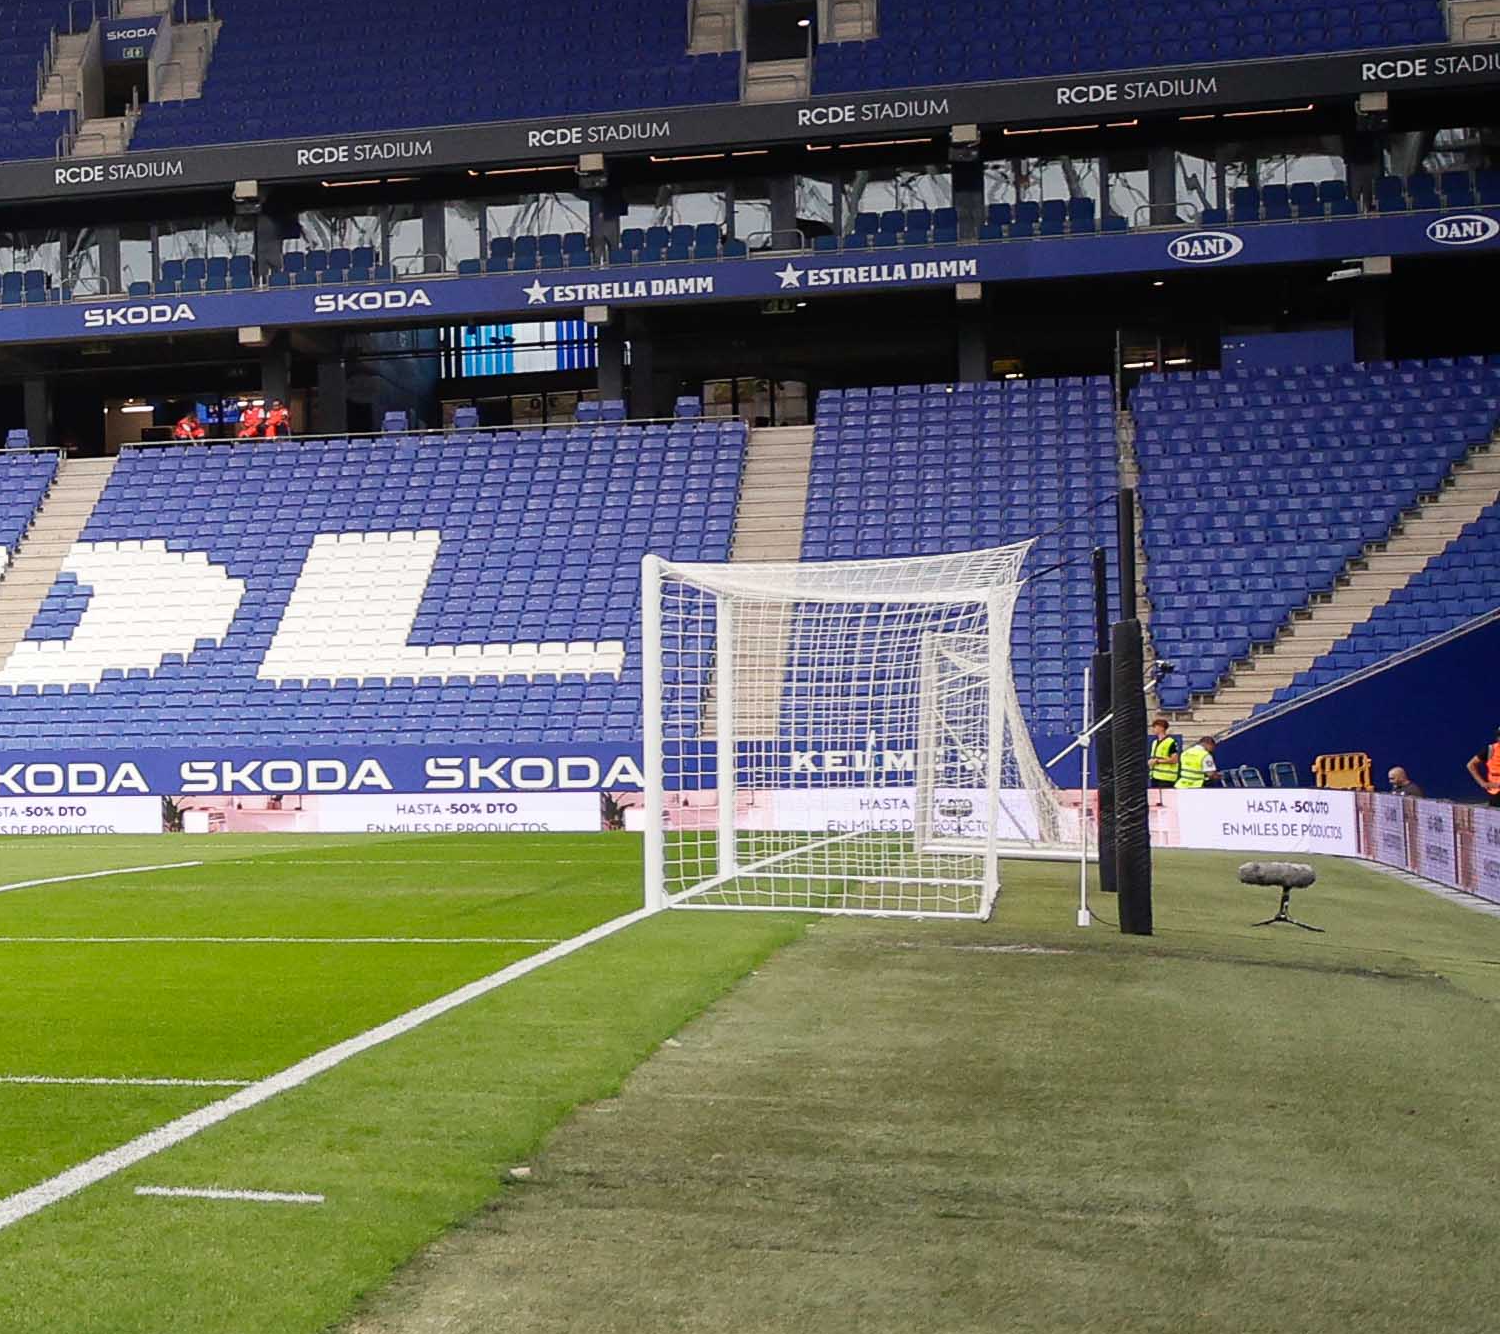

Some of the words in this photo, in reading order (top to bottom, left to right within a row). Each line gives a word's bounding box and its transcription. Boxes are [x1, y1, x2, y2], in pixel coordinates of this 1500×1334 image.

[106, 27, 158, 41] SKODA
[1361, 58, 1428, 81] RCDE
[1057, 83, 1118, 105] RCDE
[1124, 77, 1217, 100] STADIUM
[798, 104, 856, 126] RCDE
[861, 98, 949, 121] STADIUM
[528, 127, 582, 147] RCDE
[587, 121, 670, 143] STADIUM
[297, 145, 349, 166] RCDE
[354, 140, 432, 161] STADIUM
[55, 165, 104, 185] RCDE
[108, 160, 183, 180] STADIUM
[1435, 221, 1482, 239] DANI
[1176, 238, 1226, 257] DANI
[807, 263, 907, 286] ESTRELLA
[910, 259, 977, 280] DAMM
[553, 280, 648, 302] ESTRELLA
[650, 276, 713, 296] DAMM
[314, 289, 432, 313] SKODA
[81, 301, 196, 327] SKODA
[180, 759, 393, 792] SKODA
[425, 754, 646, 789] SKODA
[20, 806, 54, 817] -50%
[58, 806, 87, 817] DTO
[396, 803, 441, 814] HASTA
[445, 803, 482, 814] -50%
[486, 803, 518, 814] DTO
[859, 797, 910, 810] HASTA
[1246, 799, 1288, 813] HASTA
[11, 825, 27, 835] DE
[31, 825, 117, 835] PRODUCTOS
[366, 823, 386, 833] EN
[389, 823, 430, 833] MILES
[434, 823, 452, 833] DE
[456, 822, 550, 833] PRODUCTOS
[1222, 822, 1240, 836] EN
[1242, 823, 1280, 837] MILES
[1282, 823, 1298, 836] DE
